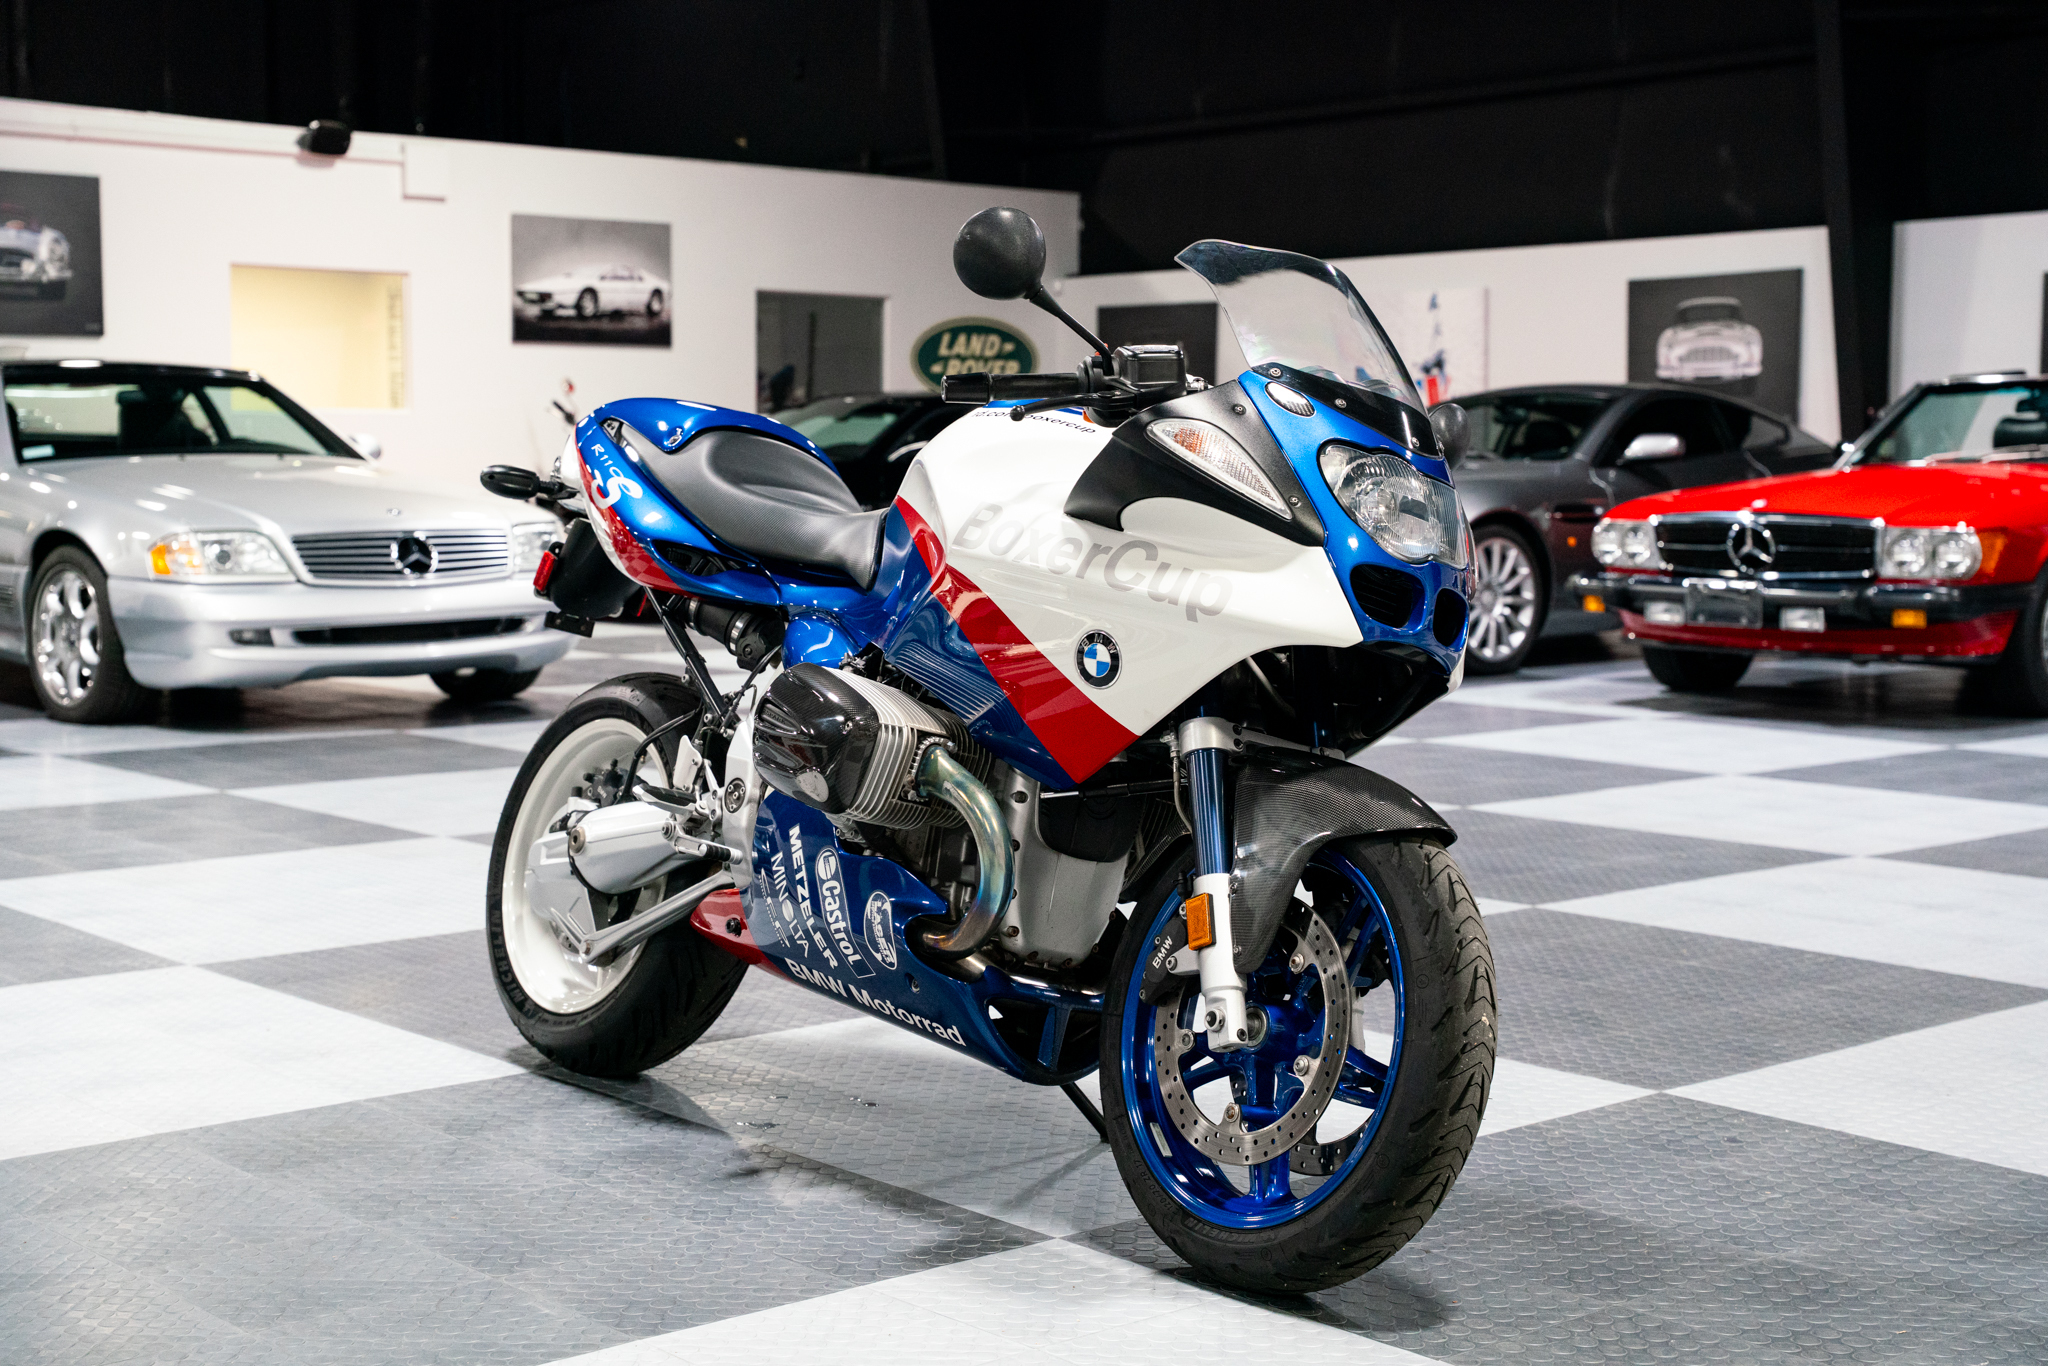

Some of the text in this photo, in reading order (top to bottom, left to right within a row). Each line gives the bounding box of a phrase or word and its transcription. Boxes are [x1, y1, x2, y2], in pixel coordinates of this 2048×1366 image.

[952, 501, 1233, 623] BoxerCup
[1081, 633, 1117, 654] BMW
[771, 851, 809, 959] MINOLTA
[789, 823, 838, 970] METZELER
[822, 880, 863, 966] Castrol
[490, 912, 525, 1009] MICHELIN
[1152, 935, 1173, 969] BMW
[785, 957, 967, 1047] BMW Motorrad
